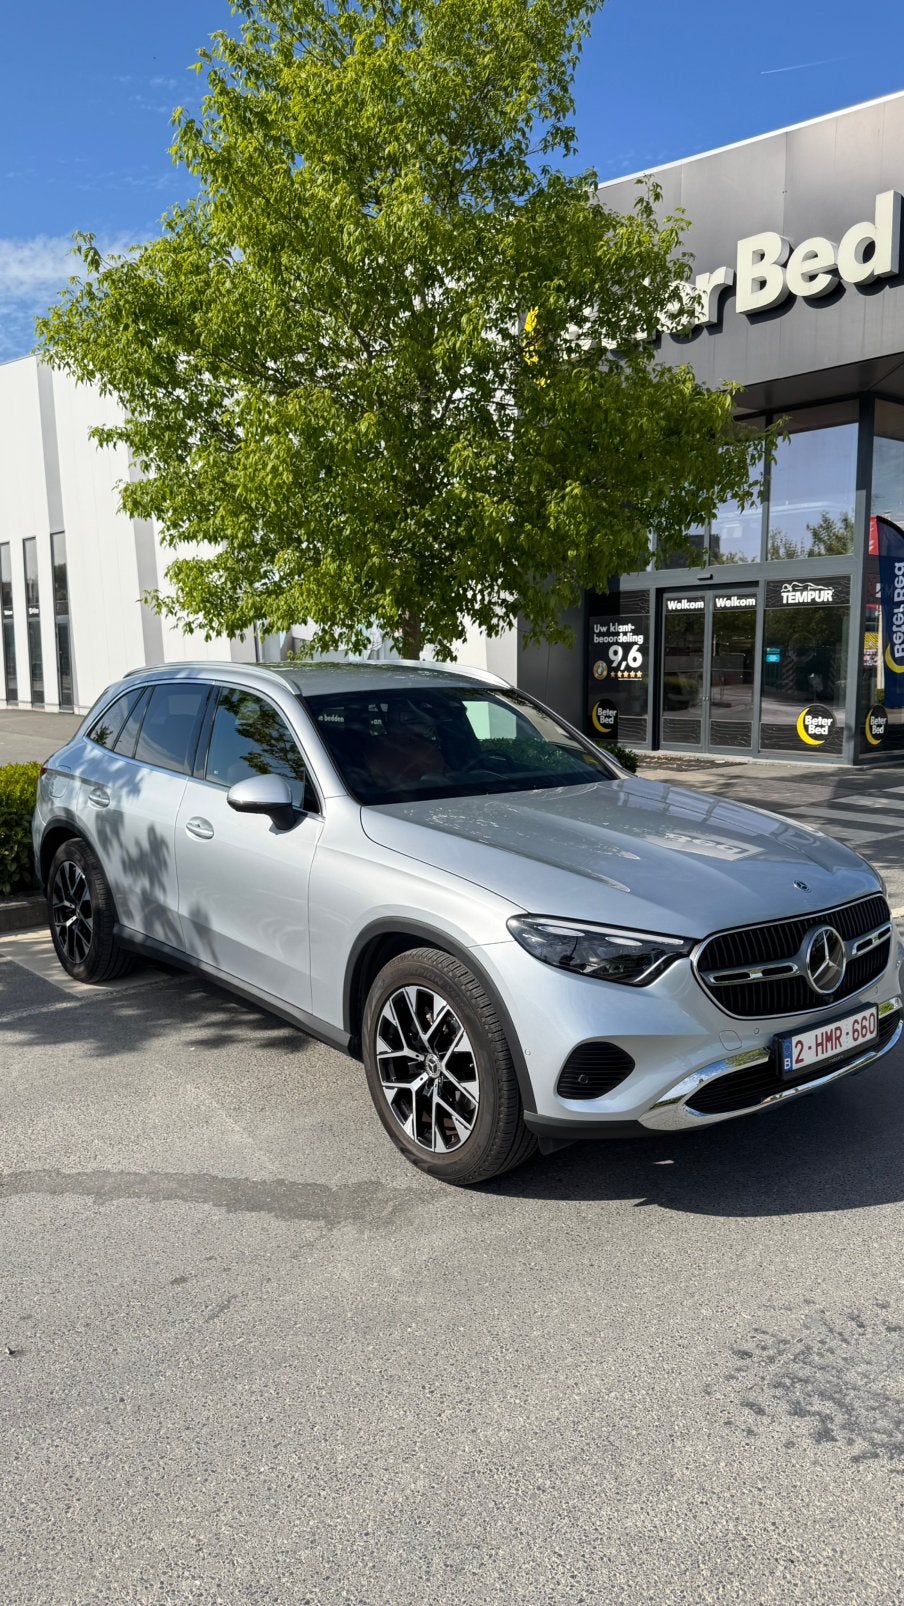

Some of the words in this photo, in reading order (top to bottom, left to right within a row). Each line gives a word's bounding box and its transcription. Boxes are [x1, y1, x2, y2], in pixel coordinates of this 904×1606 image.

[736, 190, 899, 315] Bed
[715, 593, 756, 608] Welkom
[781, 590, 833, 604] TEMPUR
[667, 599, 704, 610] Welkom
[594, 624, 607, 633] Uw
[610, 623, 635, 632] klant-
[594, 633, 644, 644] beoordeling
[608, 645, 643, 670] 9,6
[597, 707, 617, 717] Beter
[600, 716, 614, 724] Bed
[805, 715, 833, 726] Beter
[870, 716, 887, 726] Beter
[808, 725, 828, 735] Bed
[872, 725, 884, 734] Bed
[784, 1058, 791, 1069] B
